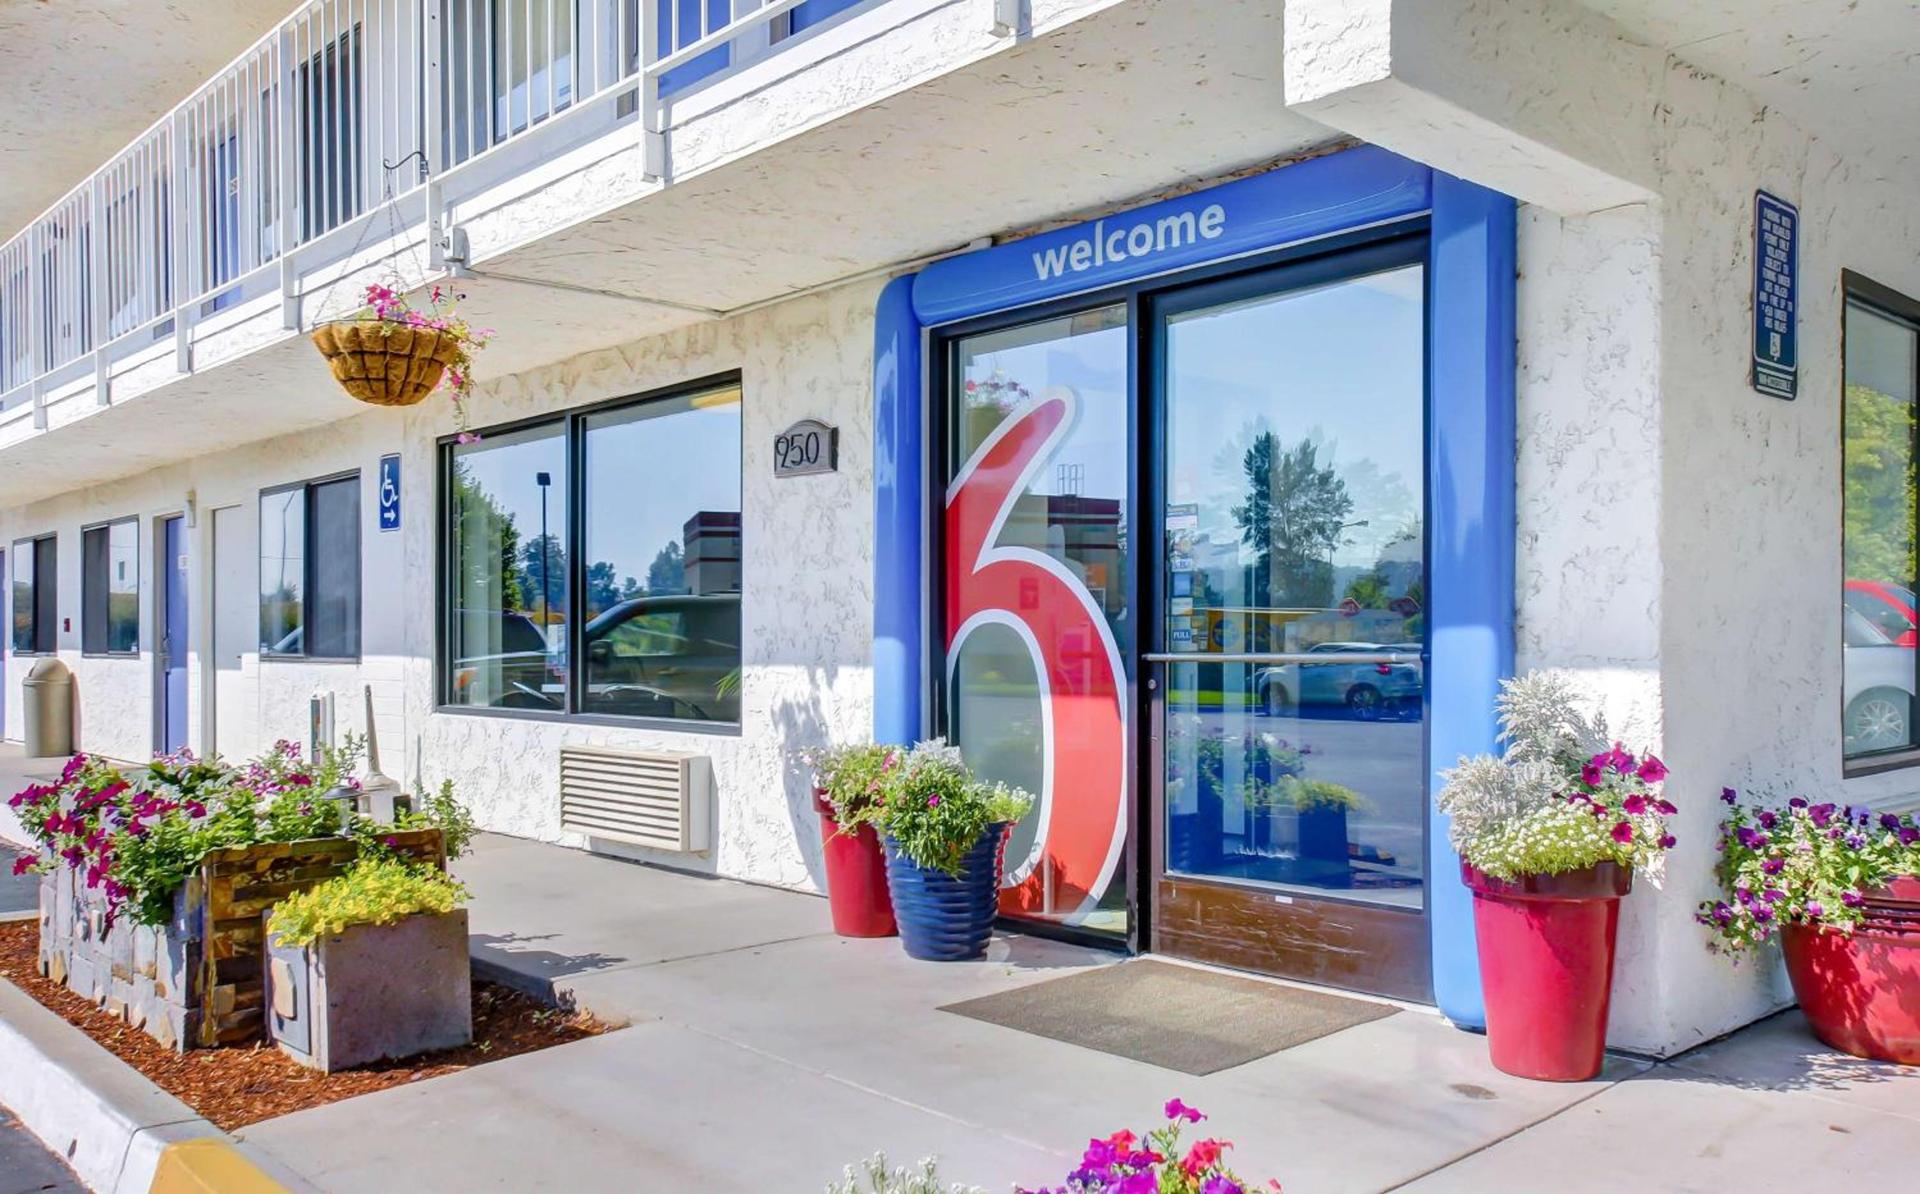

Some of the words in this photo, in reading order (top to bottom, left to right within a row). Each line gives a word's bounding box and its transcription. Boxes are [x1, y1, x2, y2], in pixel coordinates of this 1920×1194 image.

[1032, 204, 1226, 281] welcome
[776, 432, 820, 468] 950
[946, 385, 1128, 925] 6
[1173, 631, 1190, 640] PULL
